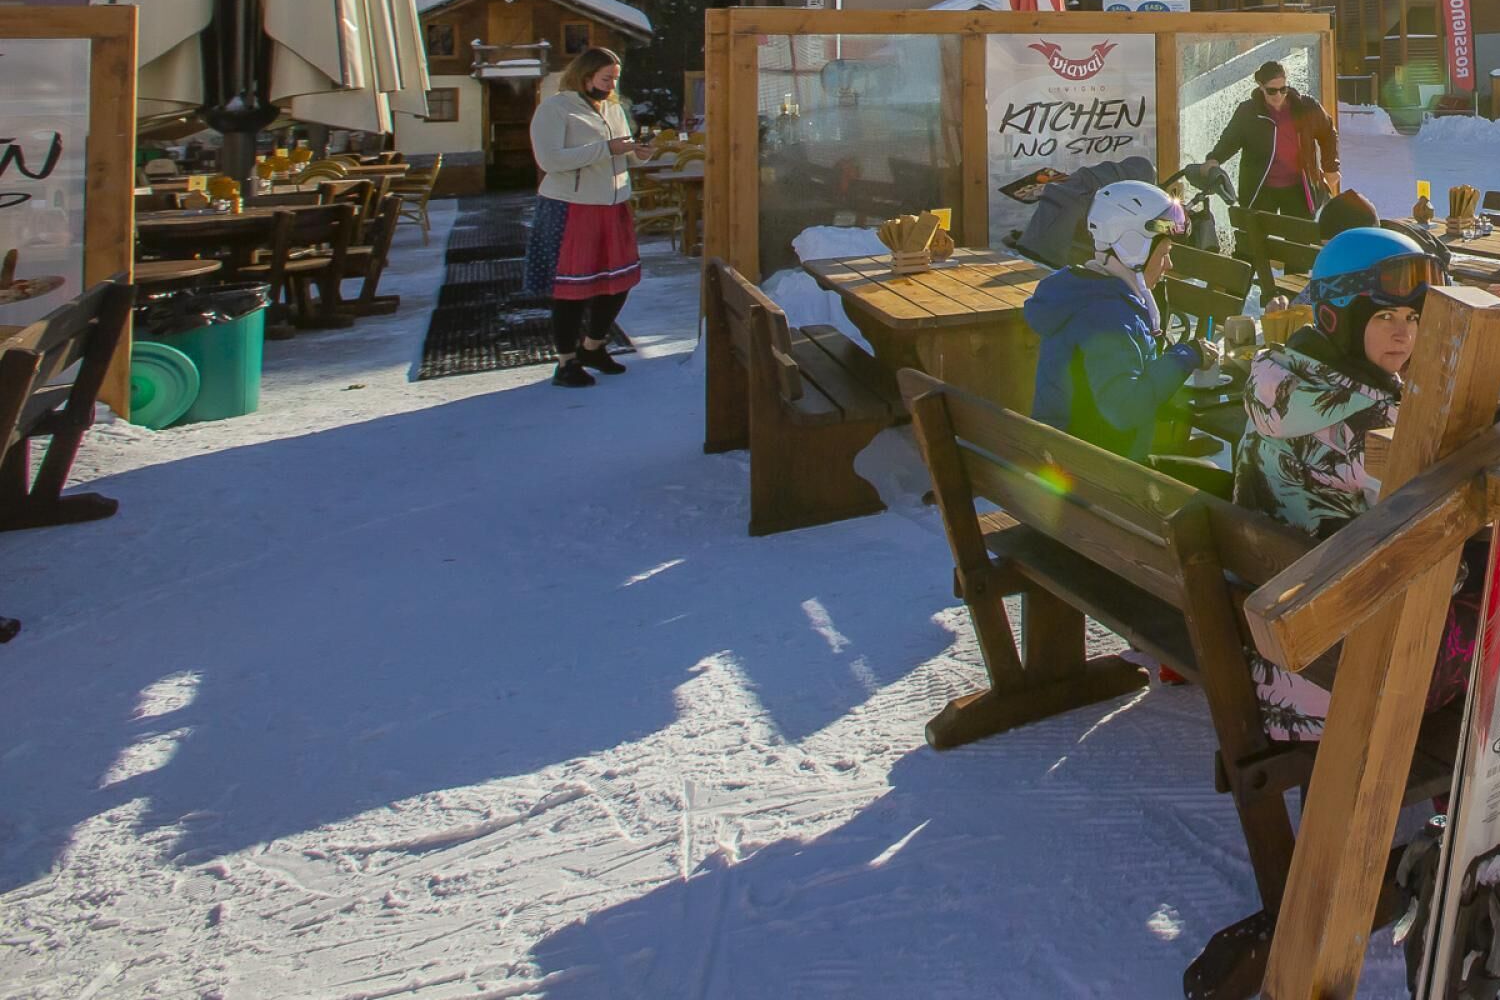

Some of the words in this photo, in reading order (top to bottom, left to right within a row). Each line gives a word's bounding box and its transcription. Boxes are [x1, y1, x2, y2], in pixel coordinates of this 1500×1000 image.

[999, 96, 1146, 135] KITCHEN
[1013, 138, 1058, 158] NO
[1065, 135, 1134, 155] STOP
